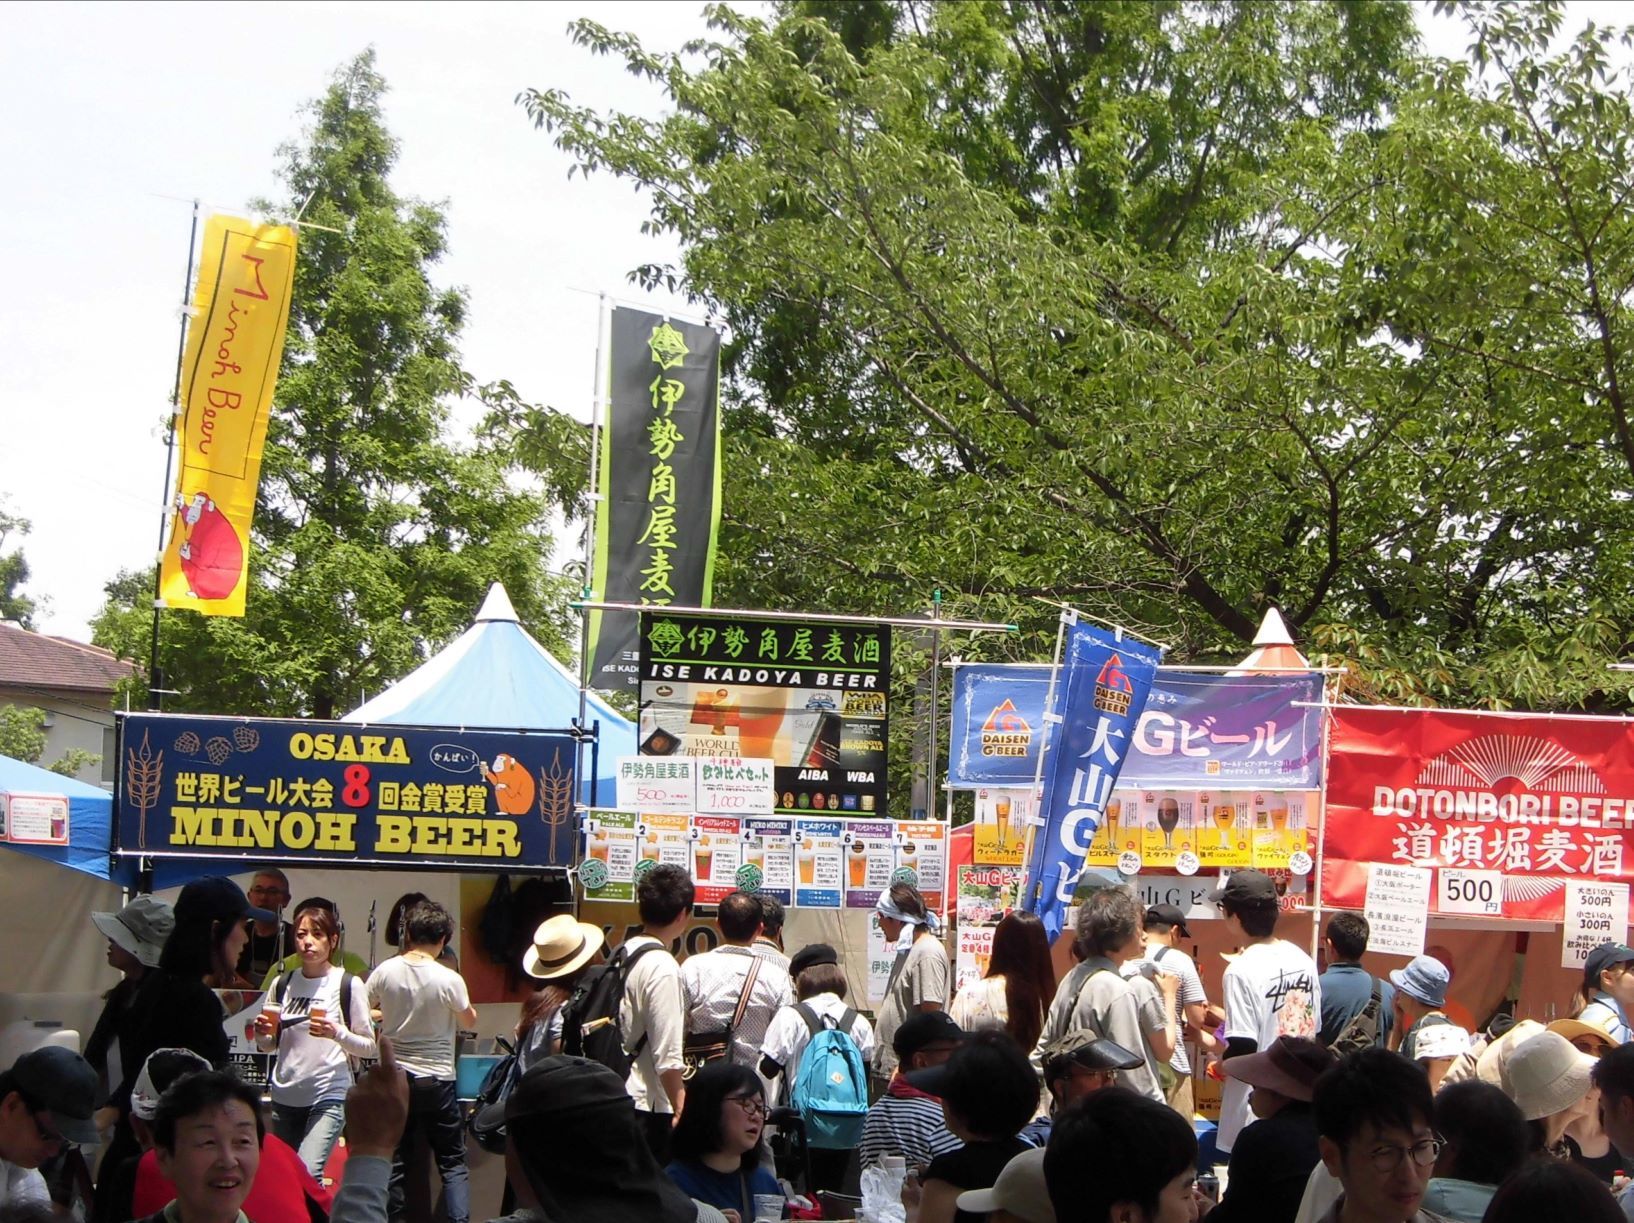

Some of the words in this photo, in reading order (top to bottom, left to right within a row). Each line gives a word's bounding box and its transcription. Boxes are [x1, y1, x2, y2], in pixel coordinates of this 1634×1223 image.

[211, 254, 269, 378] Minoh
[199, 387, 242, 455] Beer
[687, 622, 880, 663] 伊勢角屋麦酒
[651, 664, 690, 679] ISE
[704, 667, 801, 684] KADOYA
[816, 673, 876, 688] BEER
[1095, 687, 1131, 705] DAISEN
[695, 739, 740, 750] WORLD
[983, 735, 1030, 744] DAISEN
[289, 732, 411, 764] OSAKA
[983, 745, 994, 755] G
[997, 746, 1025, 756] BEER
[621, 762, 690, 779] 伊勢角屋麦酒
[702, 764, 769, 781] 飲み比べセット
[798, 769, 829, 781] AIBA
[847, 771, 875, 783] WBA
[175, 772, 334, 809] 世界ビール大会
[342, 764, 371, 808] 8
[378, 782, 488, 815] 回金賞受賞
[636, 787, 667, 801] 500
[711, 793, 745, 808] 1,000
[1372, 785, 1550, 824] DOTONBORI
[169, 806, 357, 852] MINOH
[375, 815, 522, 857] BEER
[588, 821, 595, 832] 1
[638, 825, 646, 835] 2
[692, 828, 699, 838] 3
[744, 831, 751, 840] 4
[795, 832, 802, 841] 5
[844, 834, 852, 843] 6
[1392, 822, 1624, 877] 道頓堀麦酒
[1442, 870, 1466, 878] ビール
[1447, 879, 1493, 902] 500
[1485, 902, 1498, 912] 円
[1580, 895, 1611, 907] 500円
[1579, 919, 1611, 931] 300円
